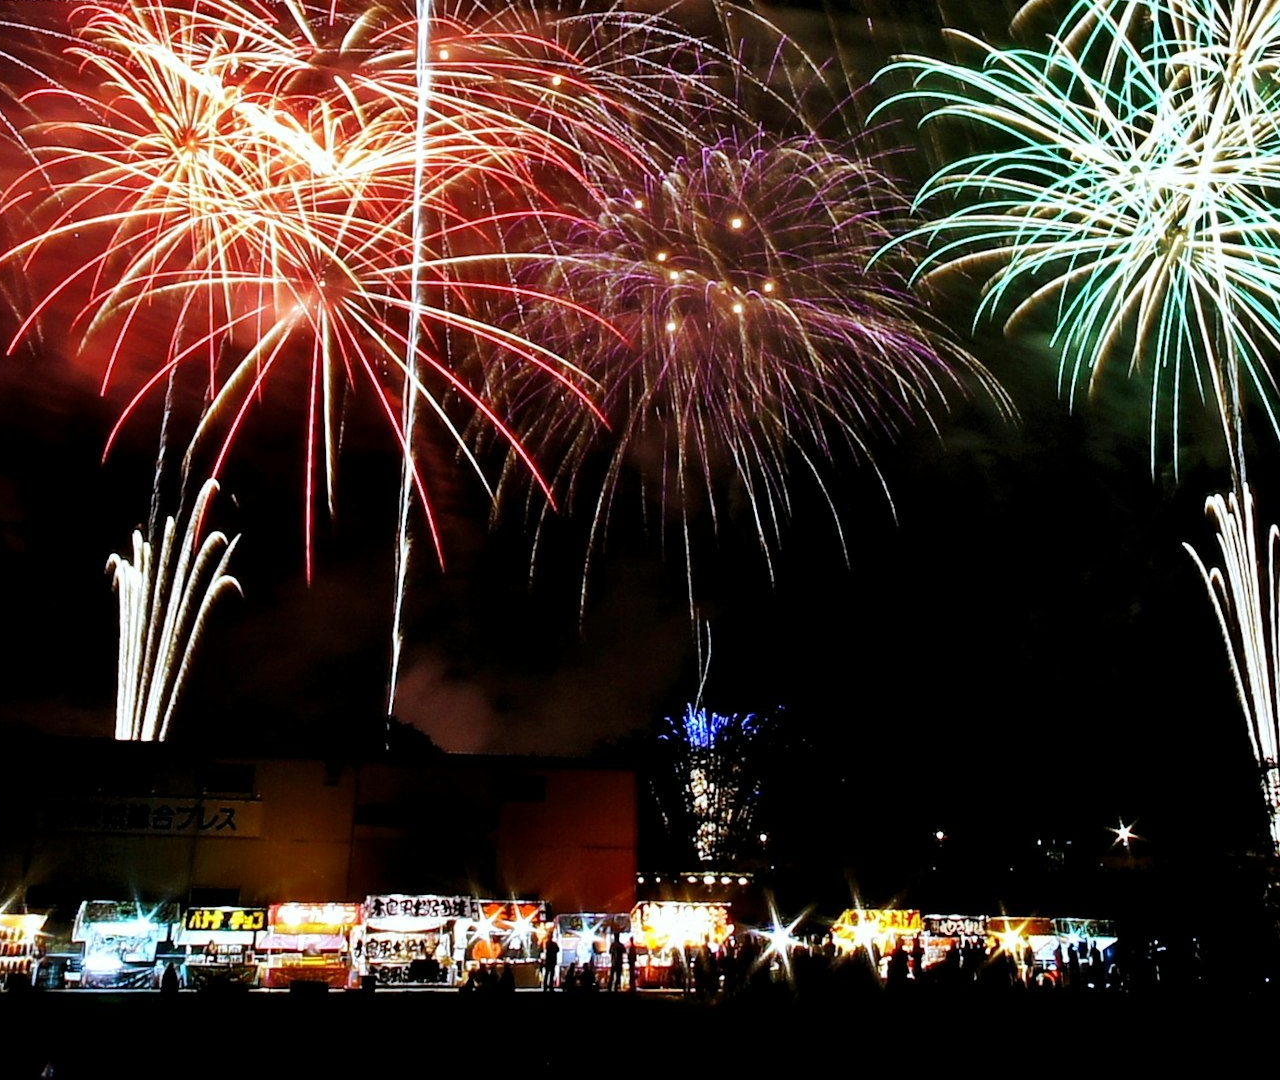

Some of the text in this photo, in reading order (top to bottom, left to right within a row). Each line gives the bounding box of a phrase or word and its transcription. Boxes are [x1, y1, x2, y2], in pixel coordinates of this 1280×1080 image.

[189, 910, 264, 930] バナナ チョコ
